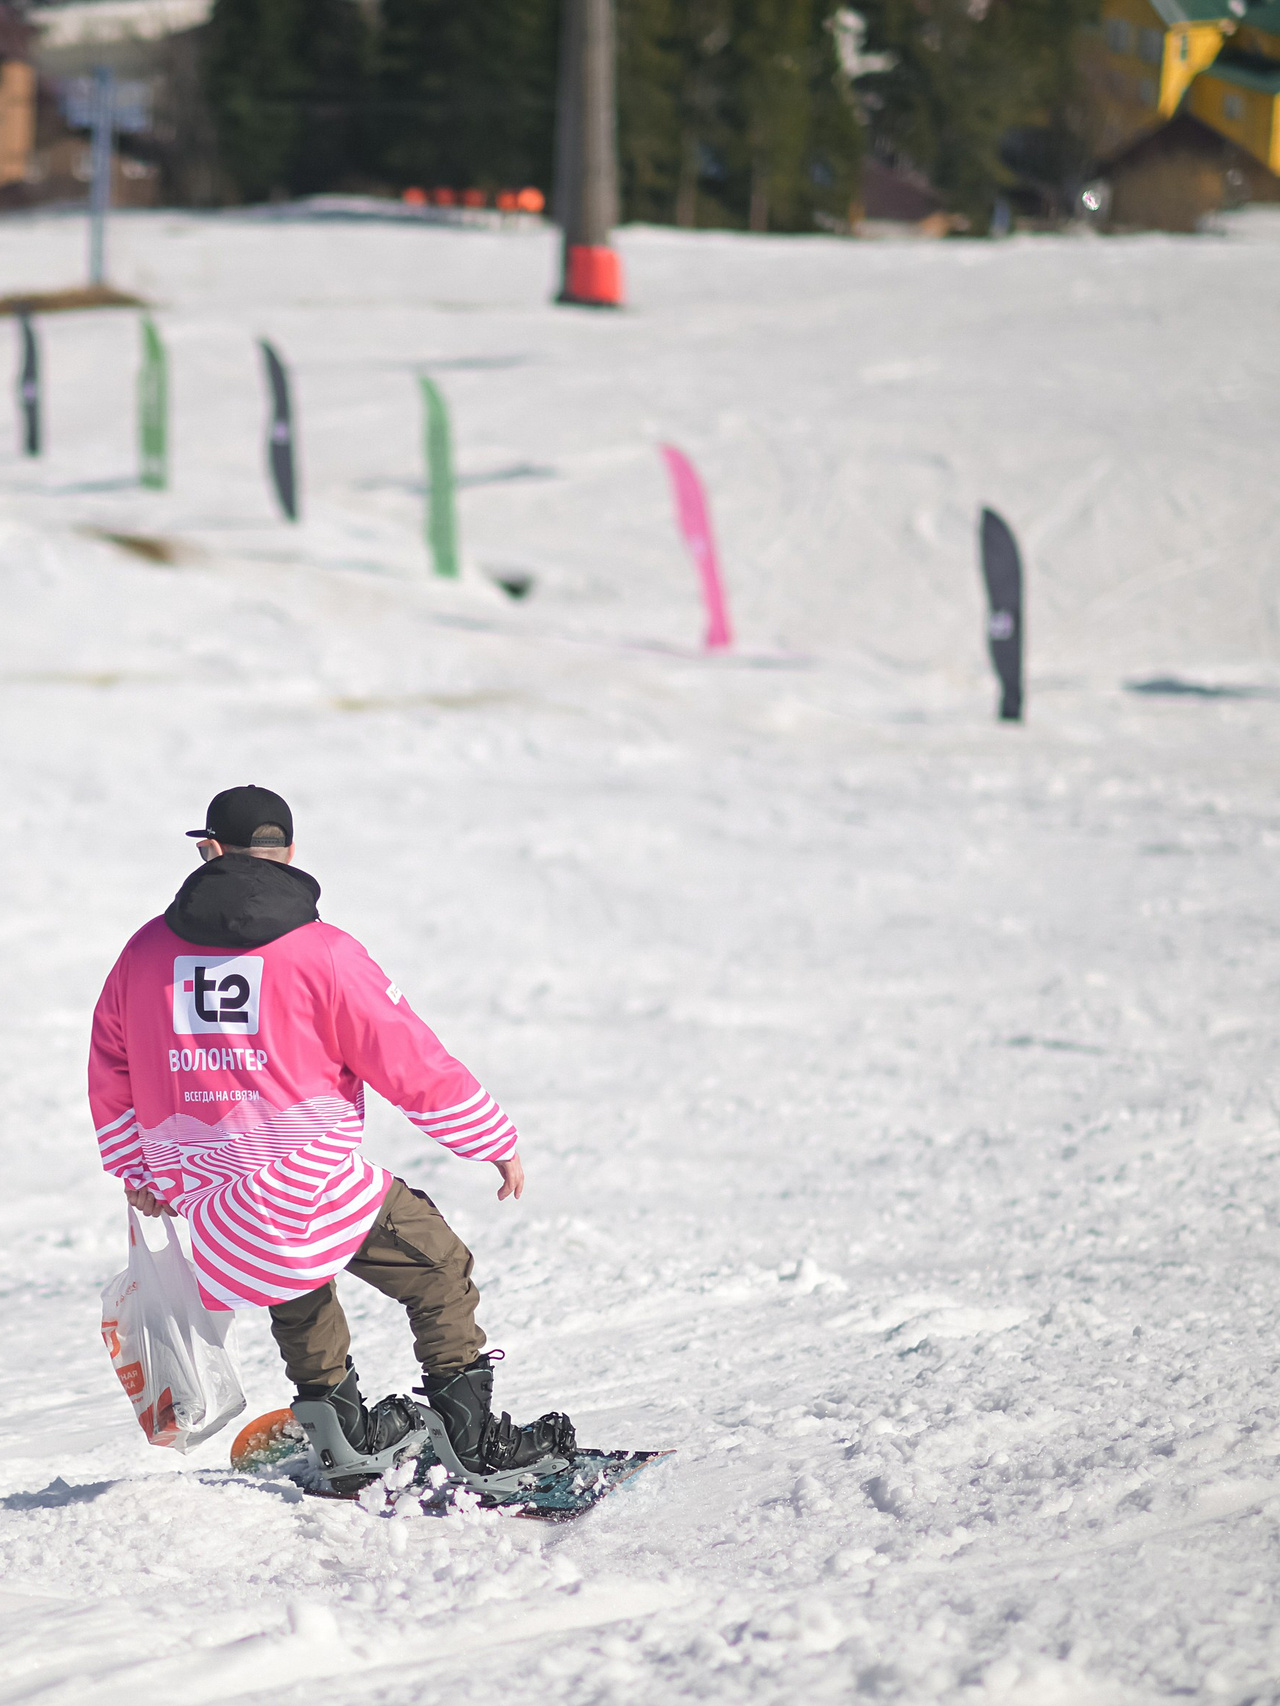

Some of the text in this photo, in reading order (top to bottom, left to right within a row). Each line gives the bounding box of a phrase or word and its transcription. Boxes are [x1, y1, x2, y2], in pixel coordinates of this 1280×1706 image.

[184, 967, 250, 1023] t2
[169, 1048, 268, 1072] ВОЛОНТЕР
[184, 1090, 260, 1103] ВСЕГДА НА СВЯЗИ
